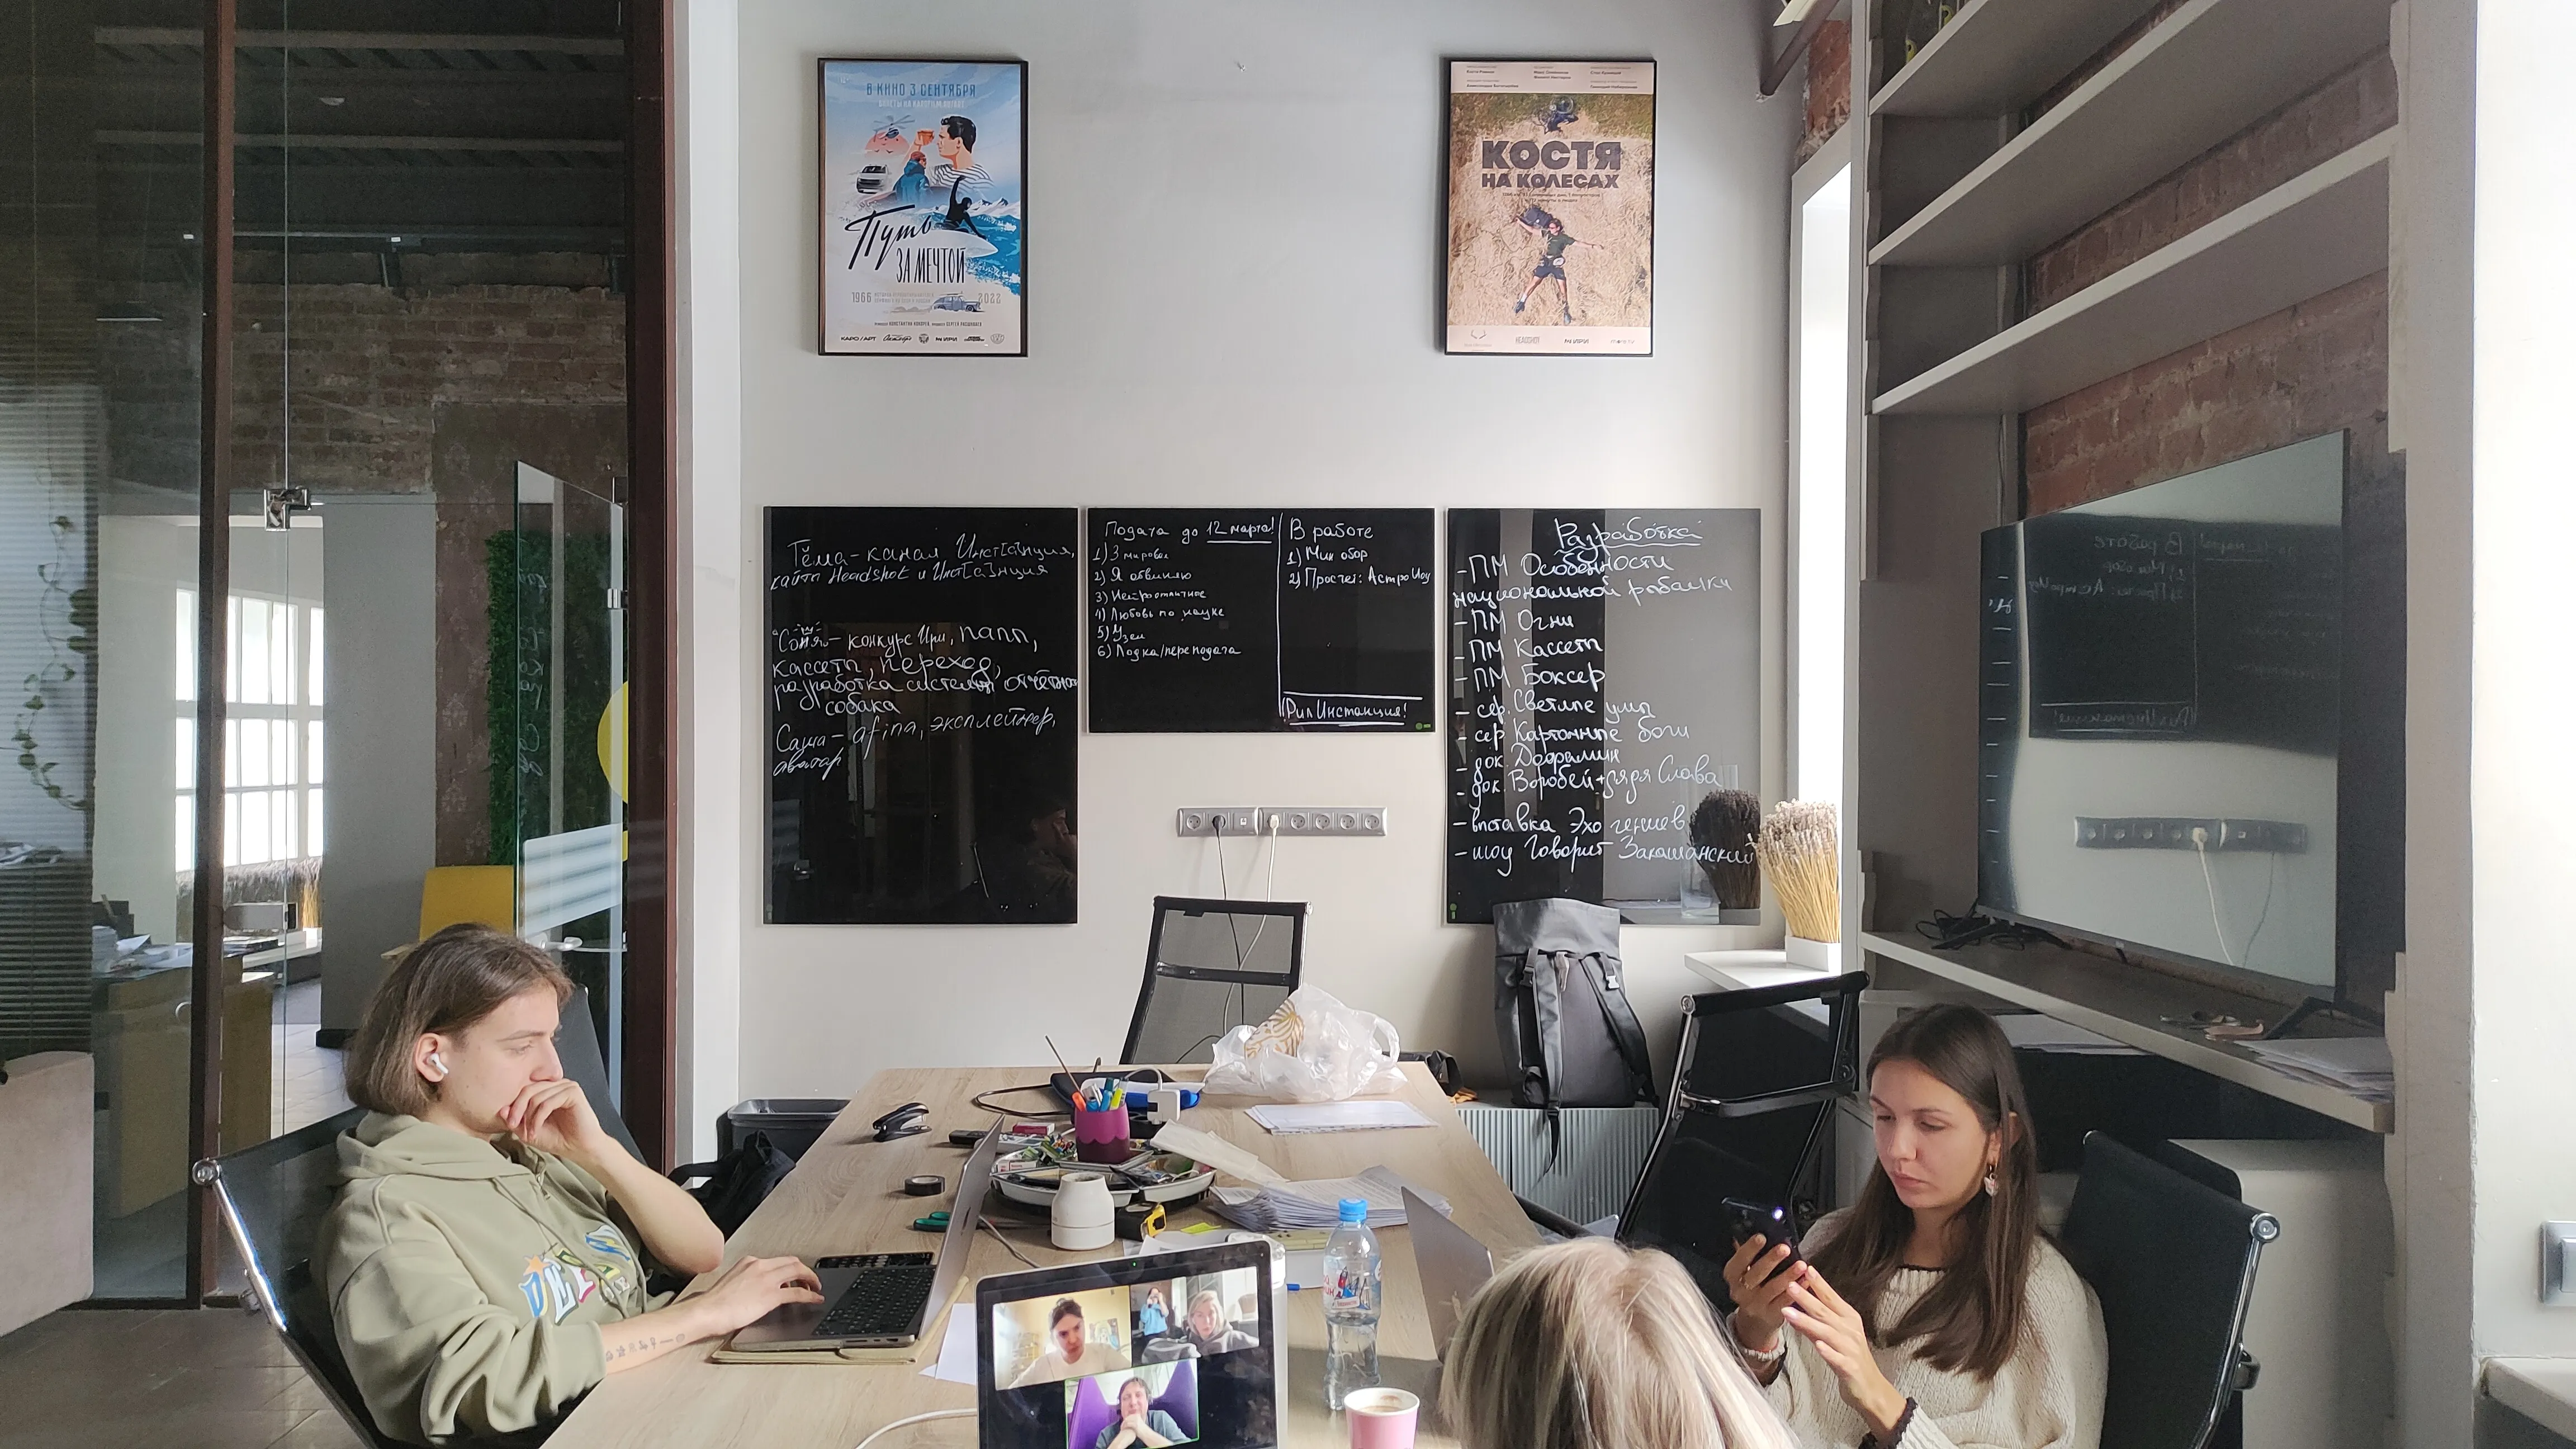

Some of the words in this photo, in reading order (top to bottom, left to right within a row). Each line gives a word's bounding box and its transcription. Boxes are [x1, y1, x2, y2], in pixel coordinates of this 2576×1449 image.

[866, 83, 872, 96] В
[877, 83, 905, 96] КИНО
[910, 84, 916, 96] 3
[921, 83, 976, 97] СЕНТЯБРЯ
[1482, 140, 1621, 170] КОСТЯ
[1482, 173, 1512, 188] НА
[1517, 173, 1620, 188] КОЛЕСАХ
[844, 204, 932, 271] Путь
[896, 247, 910, 283] ЗА
[914, 247, 966, 283] МЕЧТОЙ
[851, 292, 872, 303] 1966
[979, 293, 1001, 304] 2022
[1105, 520, 1170, 541] Подача
[1181, 528, 1198, 544] до
[1206, 520, 1228, 535] 12
[1290, 517, 1305, 540] В
[1313, 523, 1374, 543] работе
[1554, 516, 1703, 561] Разработка
[868, 546, 939, 562] канал
[1110, 544, 1119, 557] 3
[1286, 547, 1301, 568] 1)
[828, 565, 911, 584] Headshot
[918, 570, 926, 580] и
[1094, 570, 1106, 586] 2)
[1110, 566, 1123, 581] Я
[1130, 567, 1192, 580] обвиняю
[1521, 552, 1675, 576] Особенности
[1095, 590, 1109, 605] 3)
[1452, 575, 1622, 609] национальной
[1111, 607, 1154, 621] Любовь
[1182, 607, 1225, 621] науке
[1517, 608, 1574, 632] Огни
[849, 632, 913, 659] конкурс
[1097, 625, 1110, 642] 5)
[1097, 643, 1112, 659] 6)
[1521, 661, 1606, 693] Боксер
[774, 674, 904, 712] разработка
[826, 692, 902, 716] собака
[776, 723, 826, 754] Саша
[1637, 715, 1690, 743] боги
[1658, 754, 1722, 787] Слава
[1568, 807, 1602, 835] Эхо
[1472, 845, 1513, 877] шоу
[1524, 834, 1614, 873] Говорит
